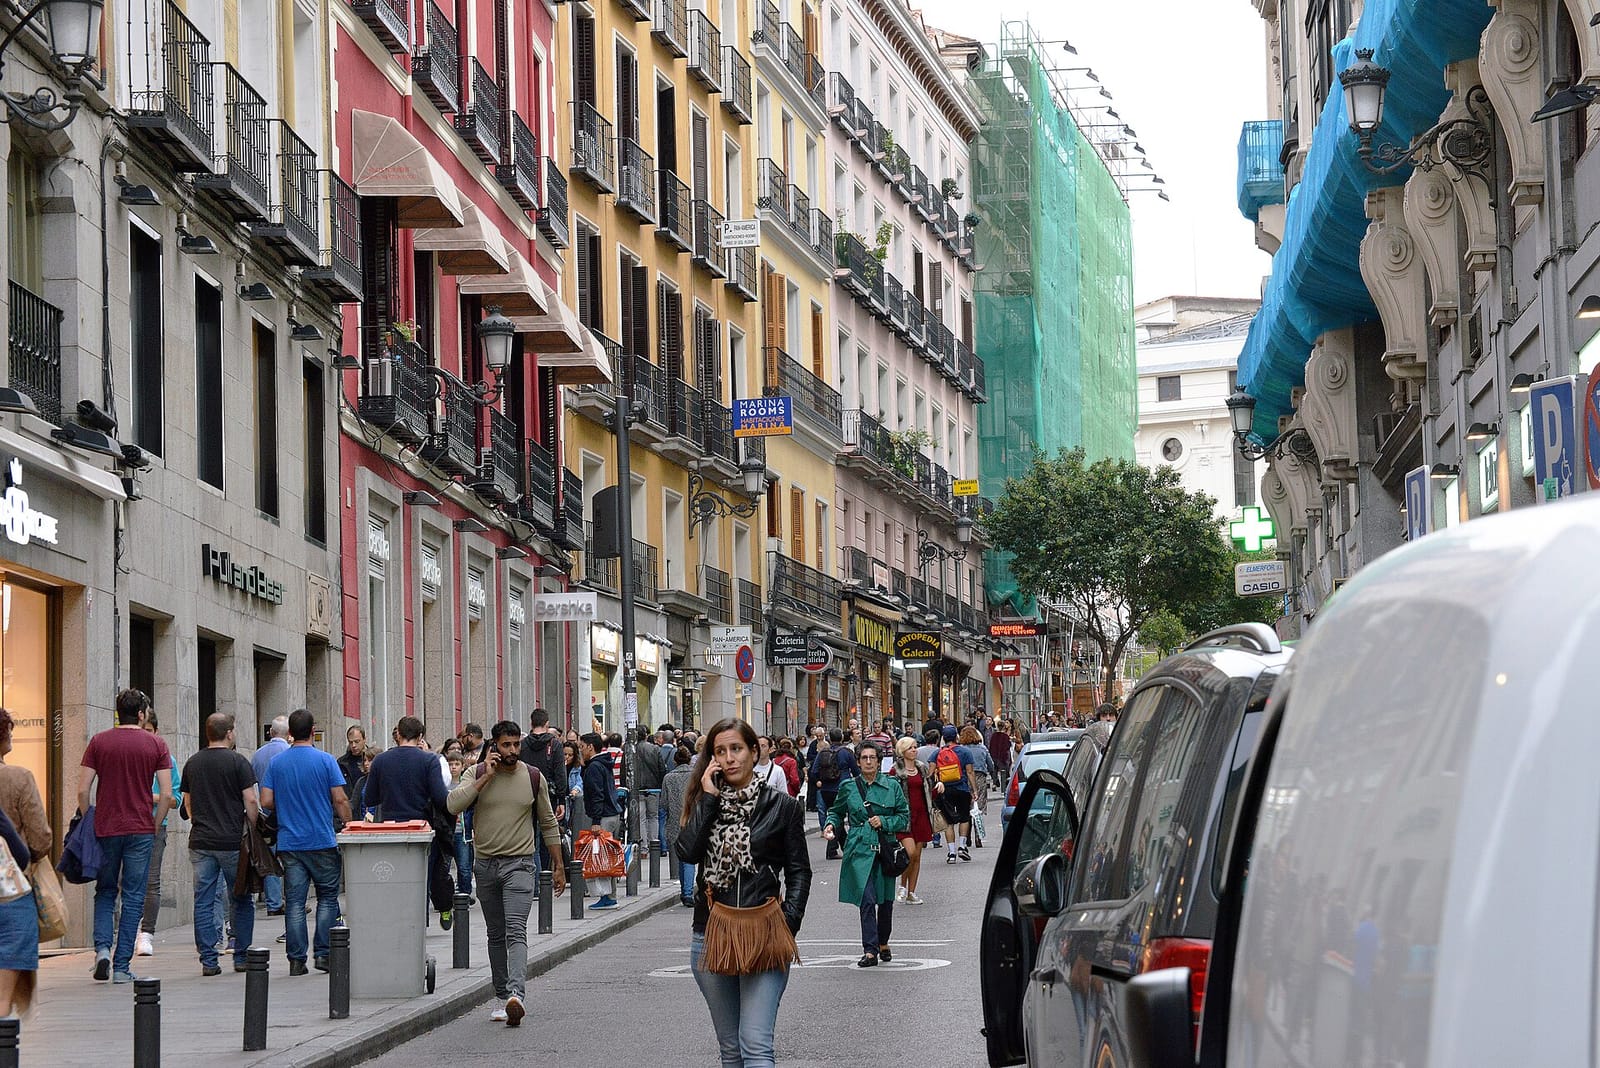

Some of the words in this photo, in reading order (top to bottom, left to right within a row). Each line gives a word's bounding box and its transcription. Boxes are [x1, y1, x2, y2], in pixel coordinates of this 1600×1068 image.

[740, 399, 785, 409] MARINA
[740, 406, 785, 417] ROOMS
[741, 422, 785, 430] MARINA
[1243, 581, 1280, 592] CASIO
[535, 600, 594, 617] Bershka
[712, 635, 750, 643] PAN-AMERICA
[855, 614, 895, 656] ORTOPEDIA
[896, 632, 940, 649] ORTOPEDIA
[774, 655, 807, 665] Restaurante
